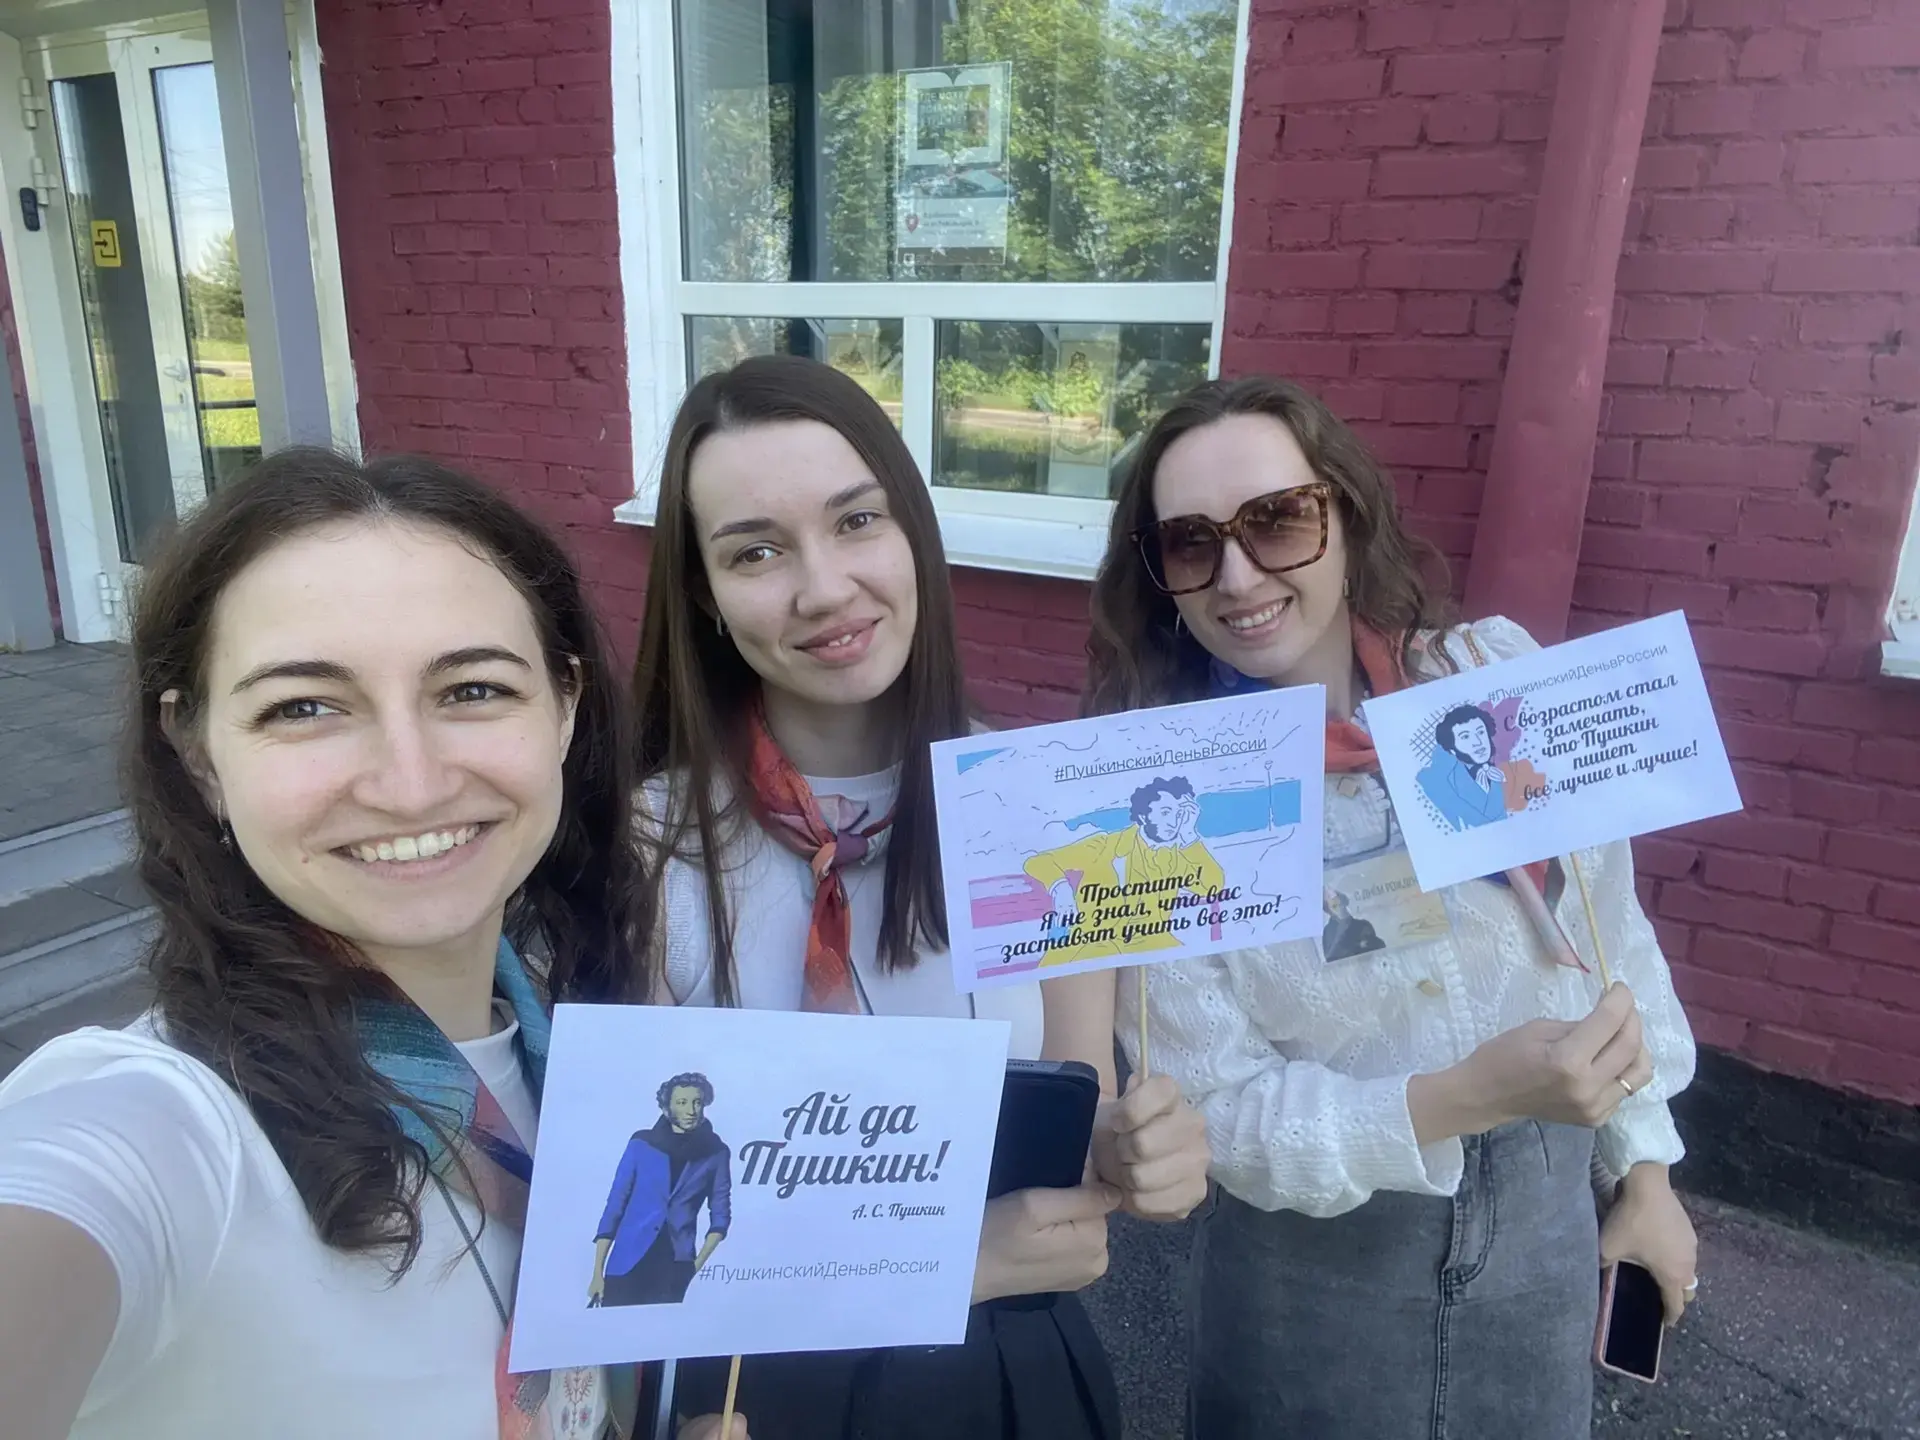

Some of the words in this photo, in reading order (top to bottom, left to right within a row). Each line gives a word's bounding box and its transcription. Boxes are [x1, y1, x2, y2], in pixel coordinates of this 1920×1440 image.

[1487, 645, 1669, 703] #ПушкинскийДеньвРоссии
[1517, 688, 1623, 729] возрастом
[1625, 674, 1679, 700] стал
[1543, 704, 1646, 745] замечать,
[1054, 738, 1267, 781] #ПушкинскийДеньвРоссии
[1541, 740, 1580, 759] что
[1581, 716, 1660, 749] Пушкин
[1572, 742, 1638, 771] пишет
[1523, 780, 1552, 801] все
[1554, 767, 1614, 794] лучше
[1616, 763, 1631, 778] и
[1632, 740, 1699, 773] лучше!
[1039, 911, 1060, 932] Я
[1061, 909, 1087, 928] не
[1090, 901, 1151, 927] знал,
[1157, 893, 1199, 911] что
[1205, 883, 1242, 904] вас
[1079, 866, 1203, 905] Простите!
[1000, 925, 1117, 964] заставят
[1121, 913, 1192, 944] учить
[1195, 902, 1229, 928] все
[1232, 894, 1282, 921] это!
[782, 1090, 851, 1141] Ай
[859, 1103, 919, 1148] да
[738, 1139, 952, 1199] Пушкин!
[852, 1204, 868, 1220] А.
[871, 1203, 884, 1218] С.
[888, 1202, 946, 1221] Пушкин
[698, 1257, 940, 1285] #ПушкинскийДеньвРоссии
